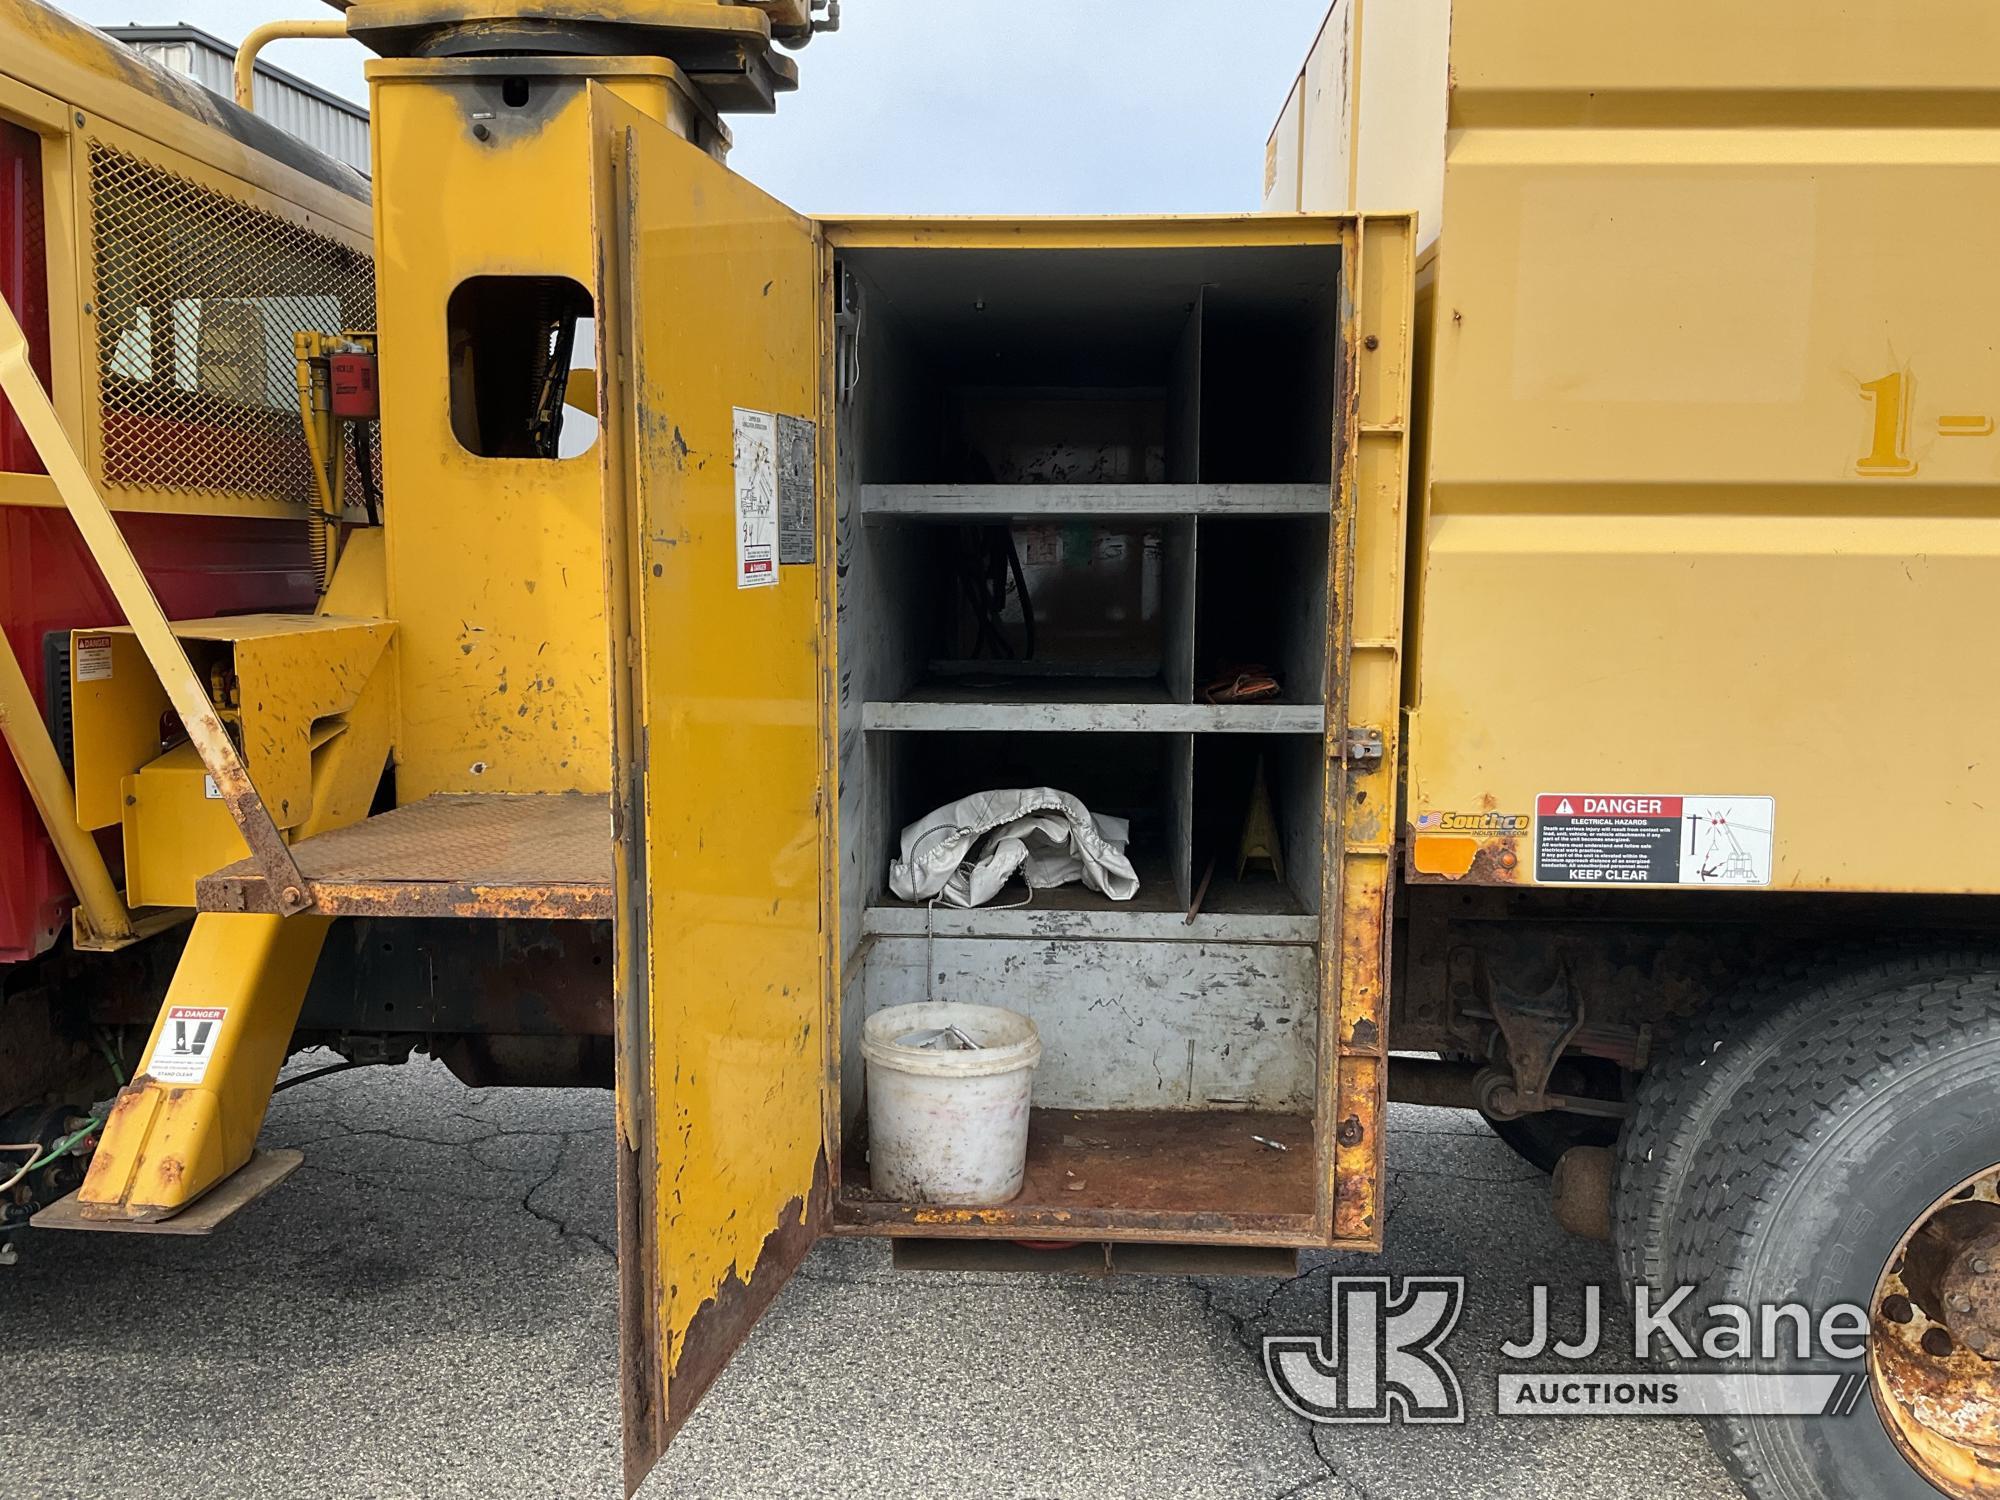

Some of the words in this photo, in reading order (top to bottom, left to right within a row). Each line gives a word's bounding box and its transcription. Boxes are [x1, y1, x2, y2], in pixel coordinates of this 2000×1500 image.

[1583, 798, 1662, 815] DANGER
[1440, 812, 1530, 830] Southco
[1571, 818, 1613, 826] ELECTRICAL
[1568, 869, 1602, 879] KEEP
[1605, 869, 1647, 880] CLEAR
[184, 1010, 221, 1018] DANGER
